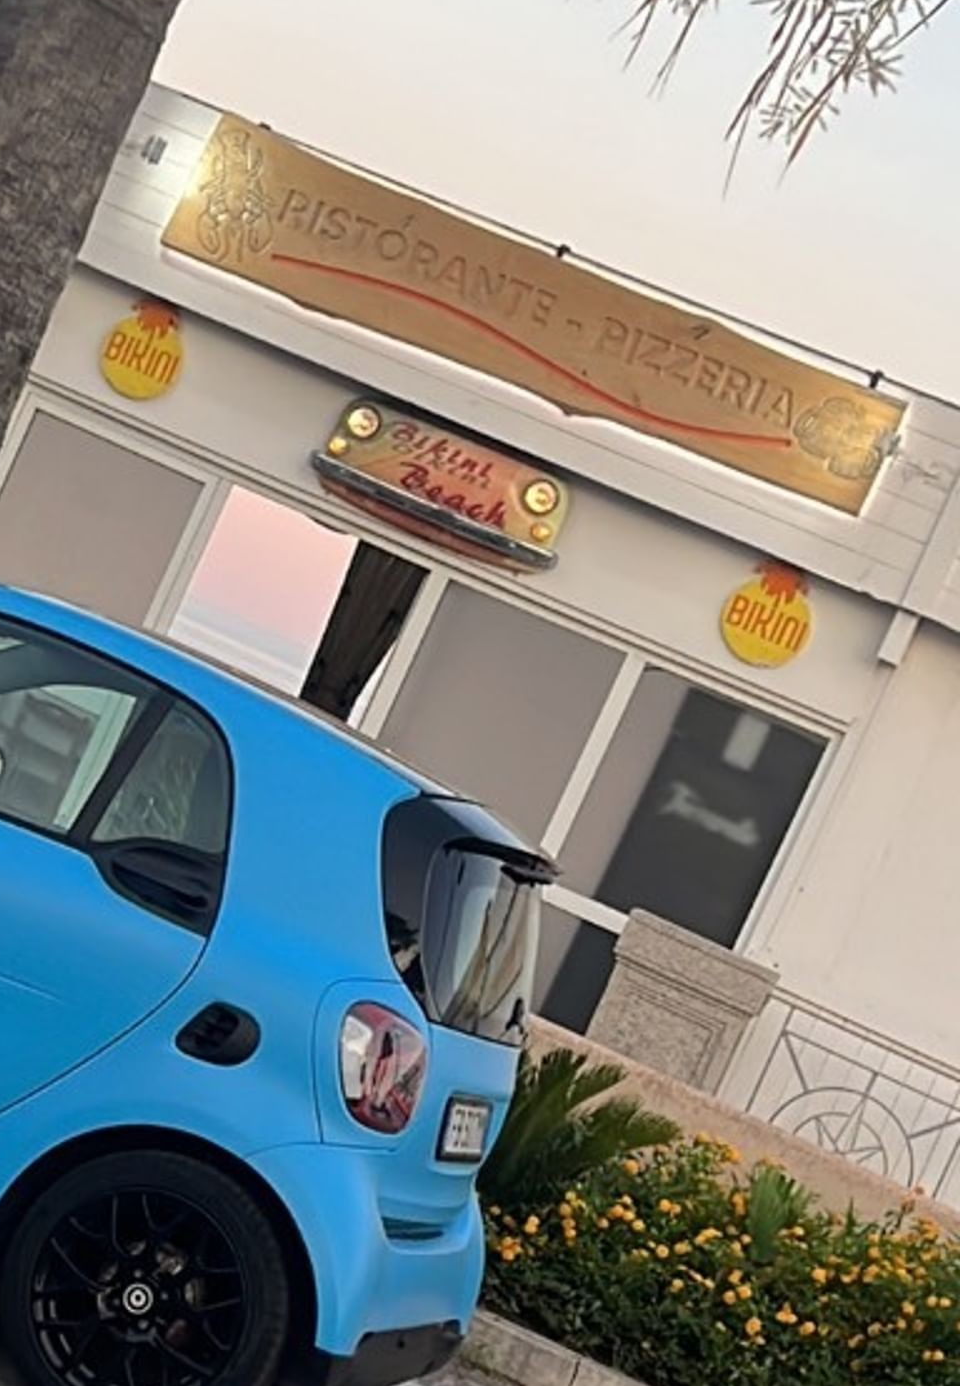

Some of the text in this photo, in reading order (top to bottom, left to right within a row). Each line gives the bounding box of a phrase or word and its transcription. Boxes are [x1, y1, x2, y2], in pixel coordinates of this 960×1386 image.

[594, 315, 795, 430] PIZZERIA
[392, 420, 493, 481] Bikini
[400, 461, 506, 529] Beach
